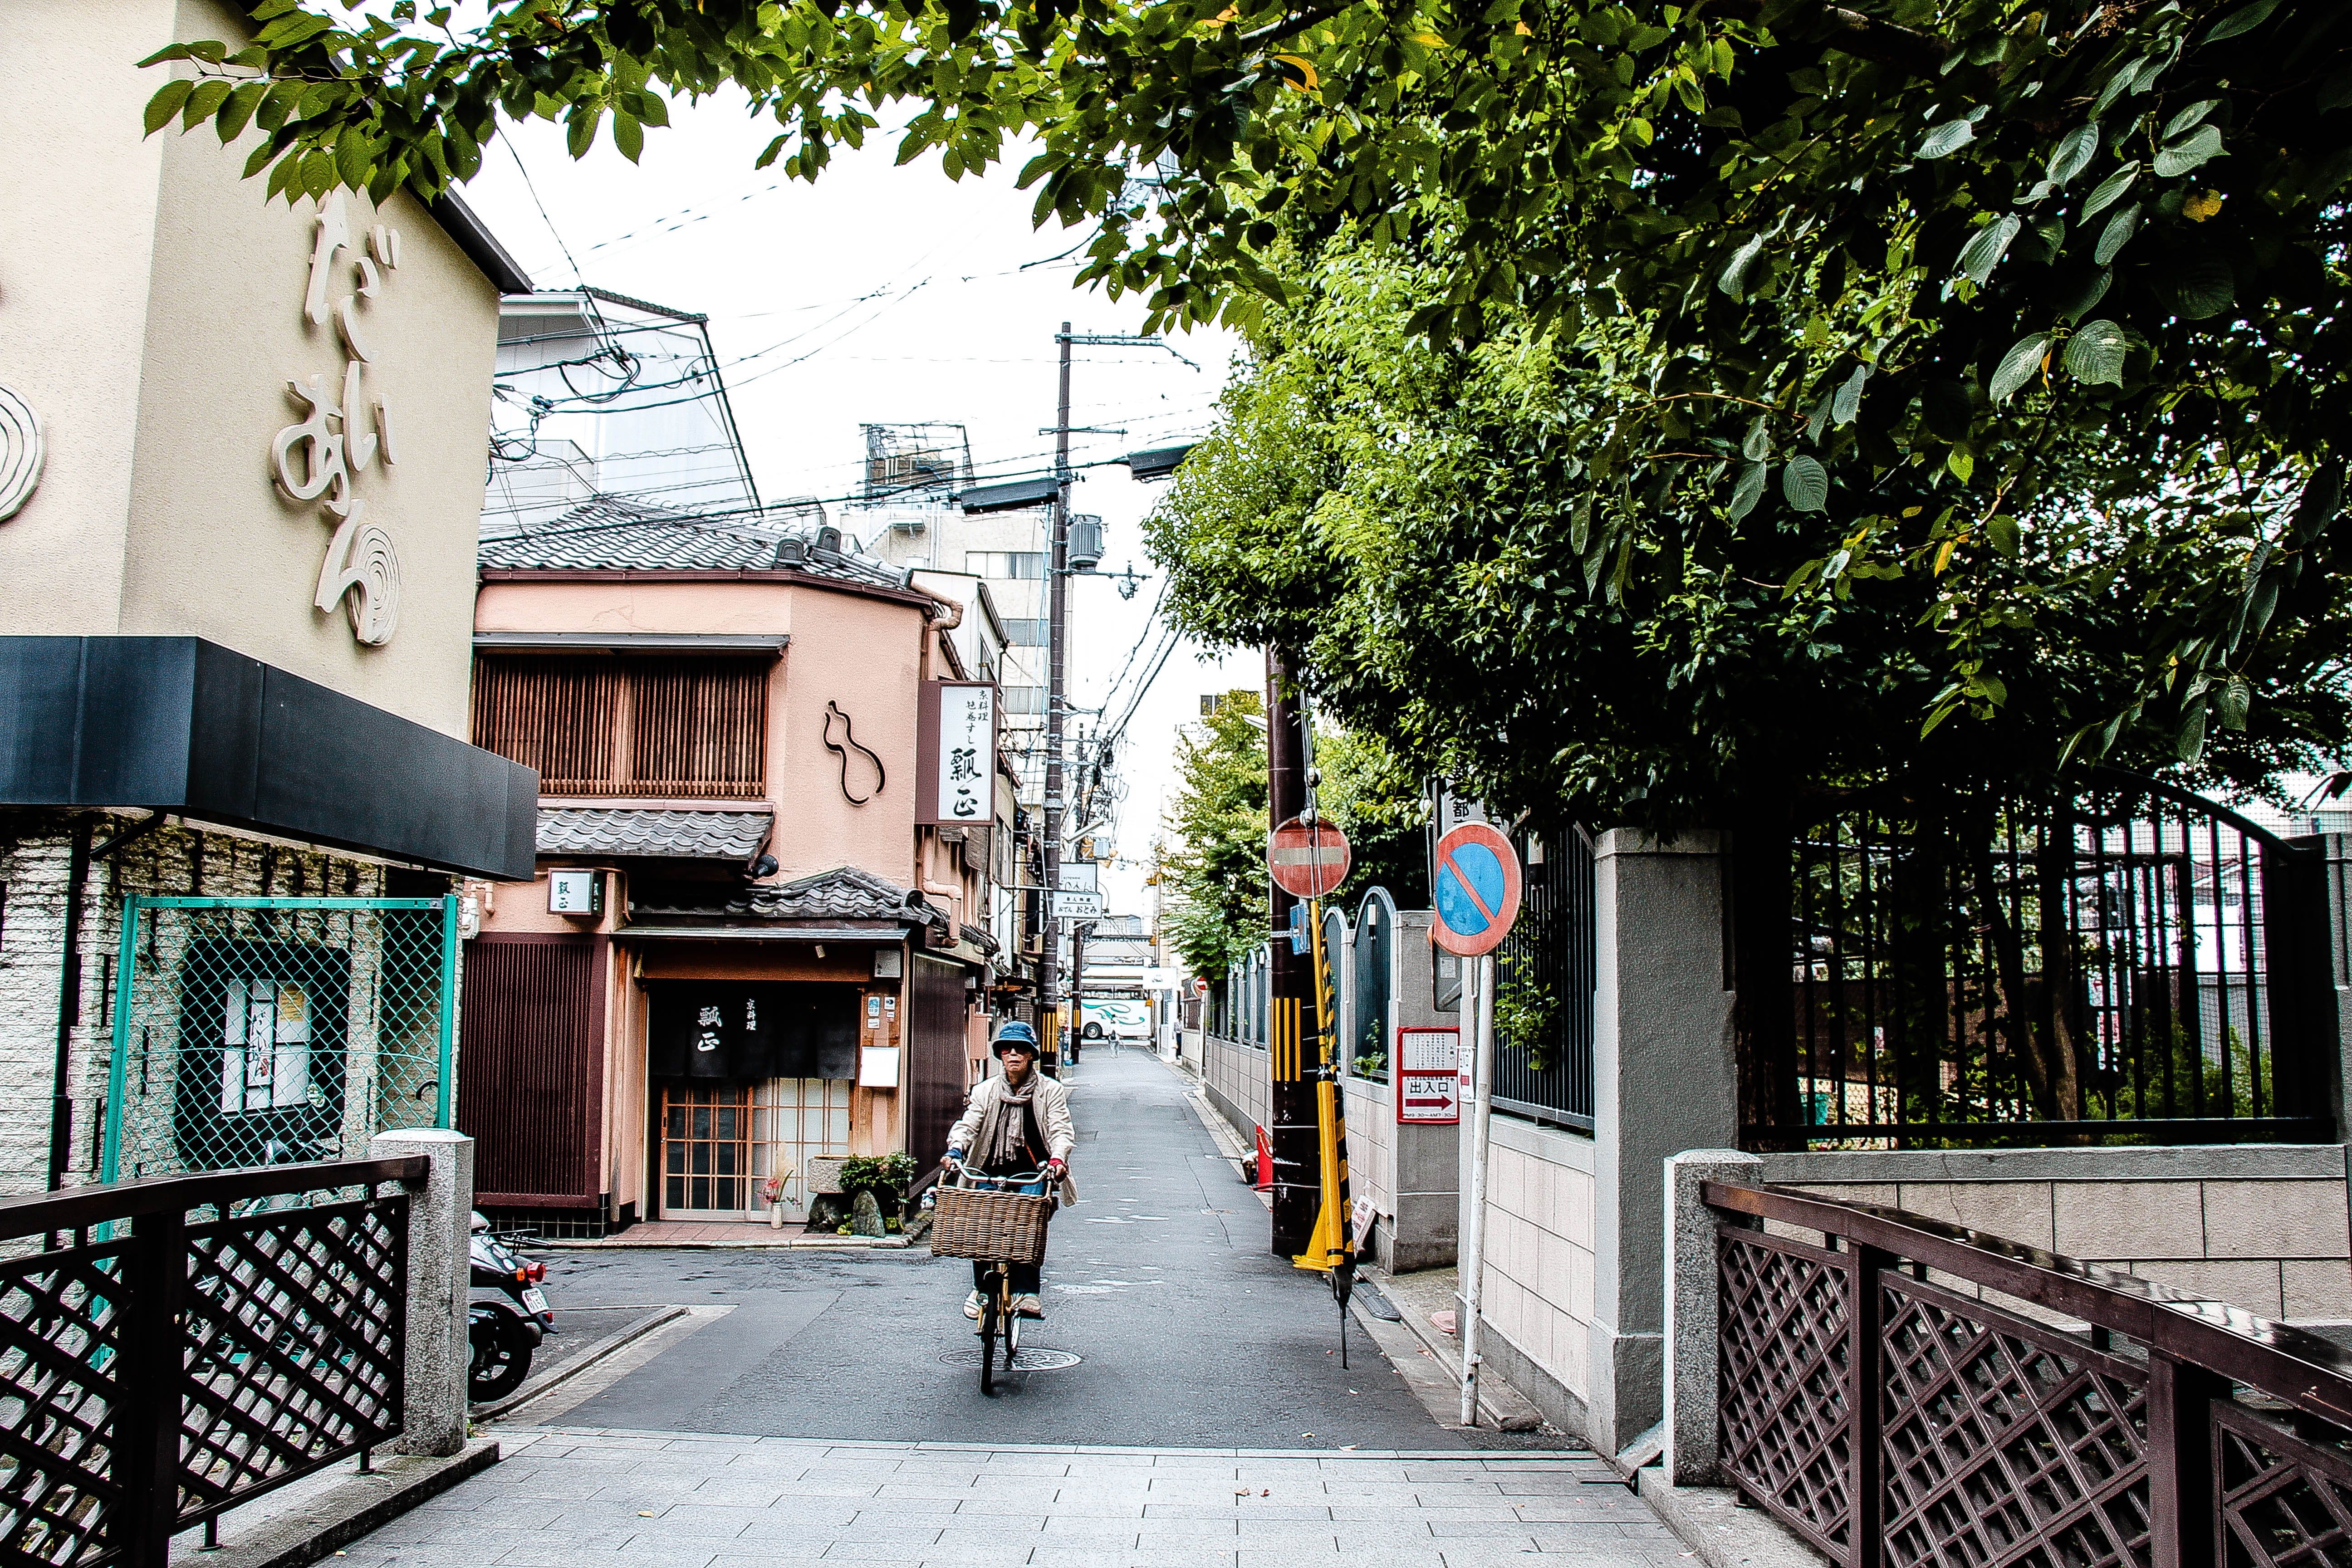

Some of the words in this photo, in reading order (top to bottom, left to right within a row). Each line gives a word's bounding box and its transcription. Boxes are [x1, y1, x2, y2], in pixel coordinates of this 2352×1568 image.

[978, 689, 989, 721] 京料理
[950, 747, 982, 817] 瓢正
[697, 1006, 722, 1052] 瓢正
[746, 998, 756, 1031] 京料理
[1410, 1081, 1449, 1094] 出入口
